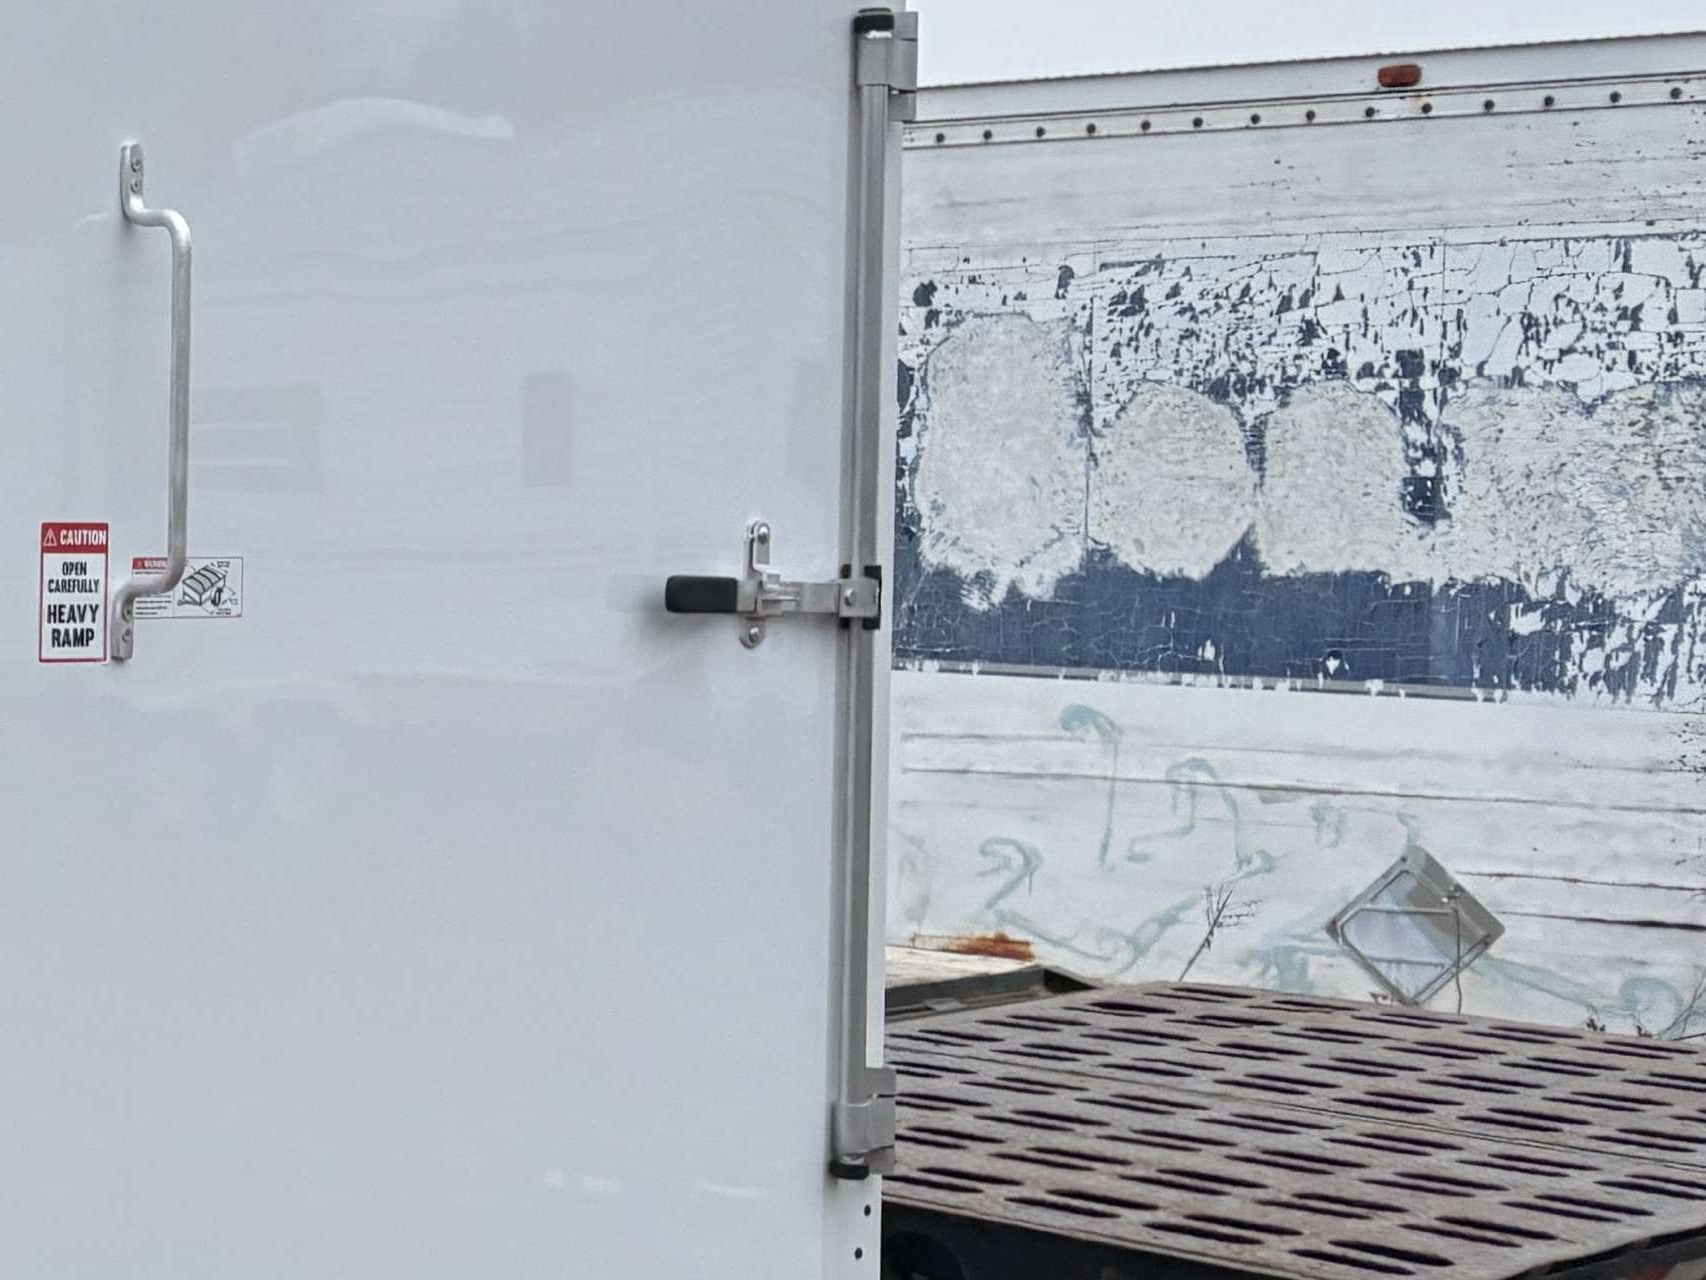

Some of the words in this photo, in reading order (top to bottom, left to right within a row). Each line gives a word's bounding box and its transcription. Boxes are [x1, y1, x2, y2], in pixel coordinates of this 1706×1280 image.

[59, 528, 107, 546] CAUTION
[62, 561, 87, 576] OPEN
[47, 579, 100, 593] CAREFULLY
[47, 604, 100, 624] HEAVY
[51, 627, 95, 648] RAMP
